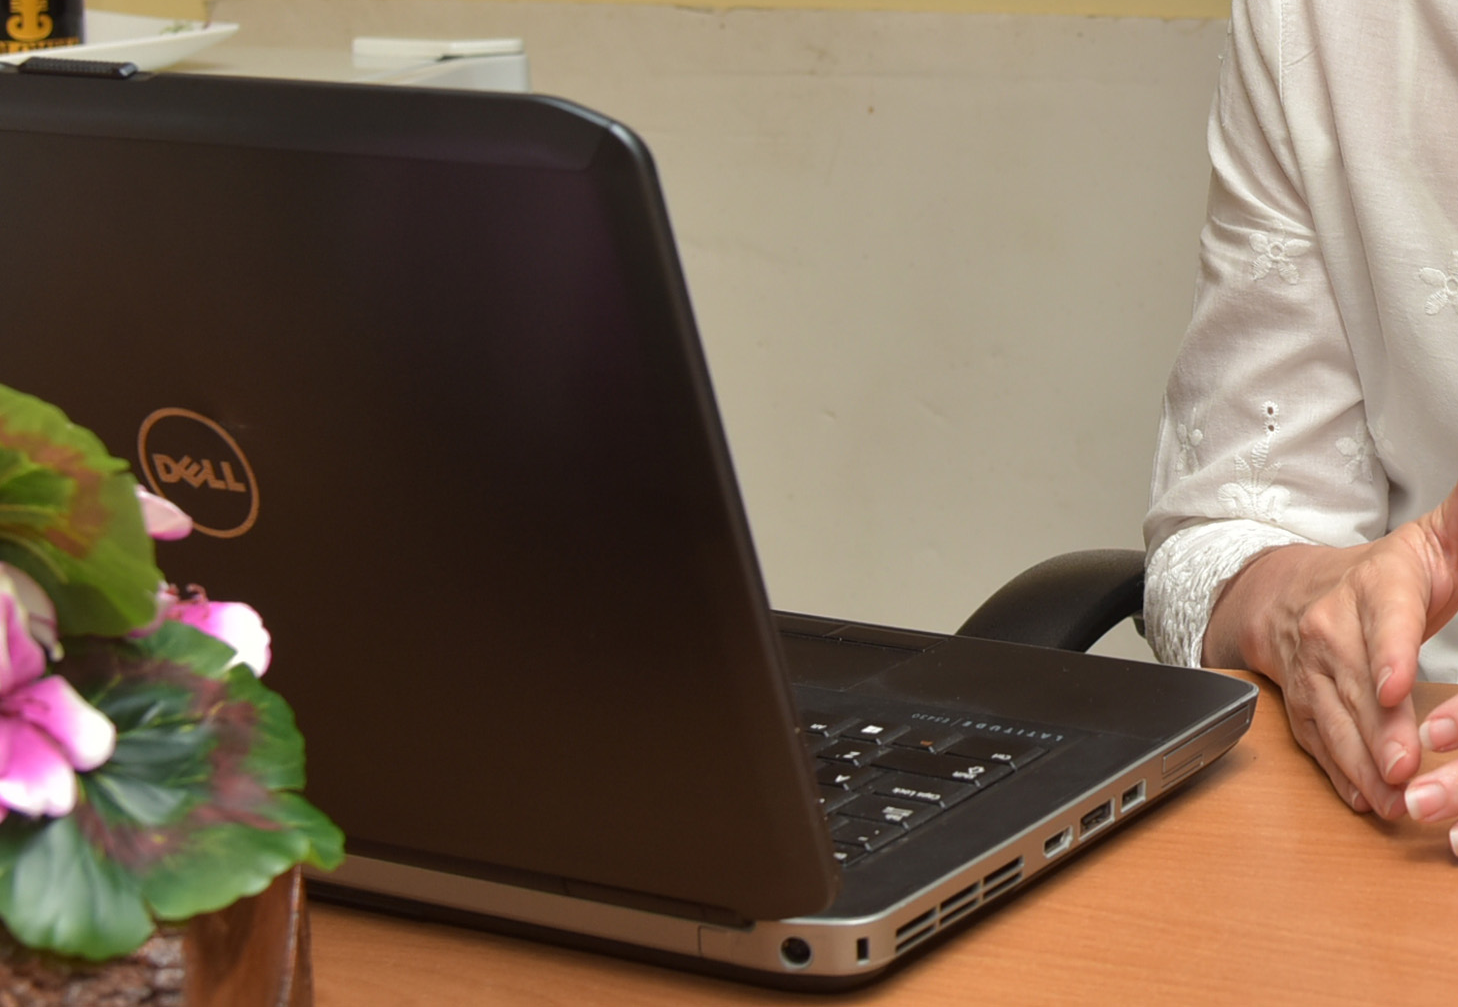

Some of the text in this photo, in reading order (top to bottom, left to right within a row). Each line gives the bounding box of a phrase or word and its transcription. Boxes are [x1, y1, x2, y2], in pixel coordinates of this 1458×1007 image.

[153, 453, 246, 493] DELL
[911, 713, 1064, 741] LATITUDE E5430
[835, 775, 851, 783] A
[892, 787, 941, 800] Caps Lock
